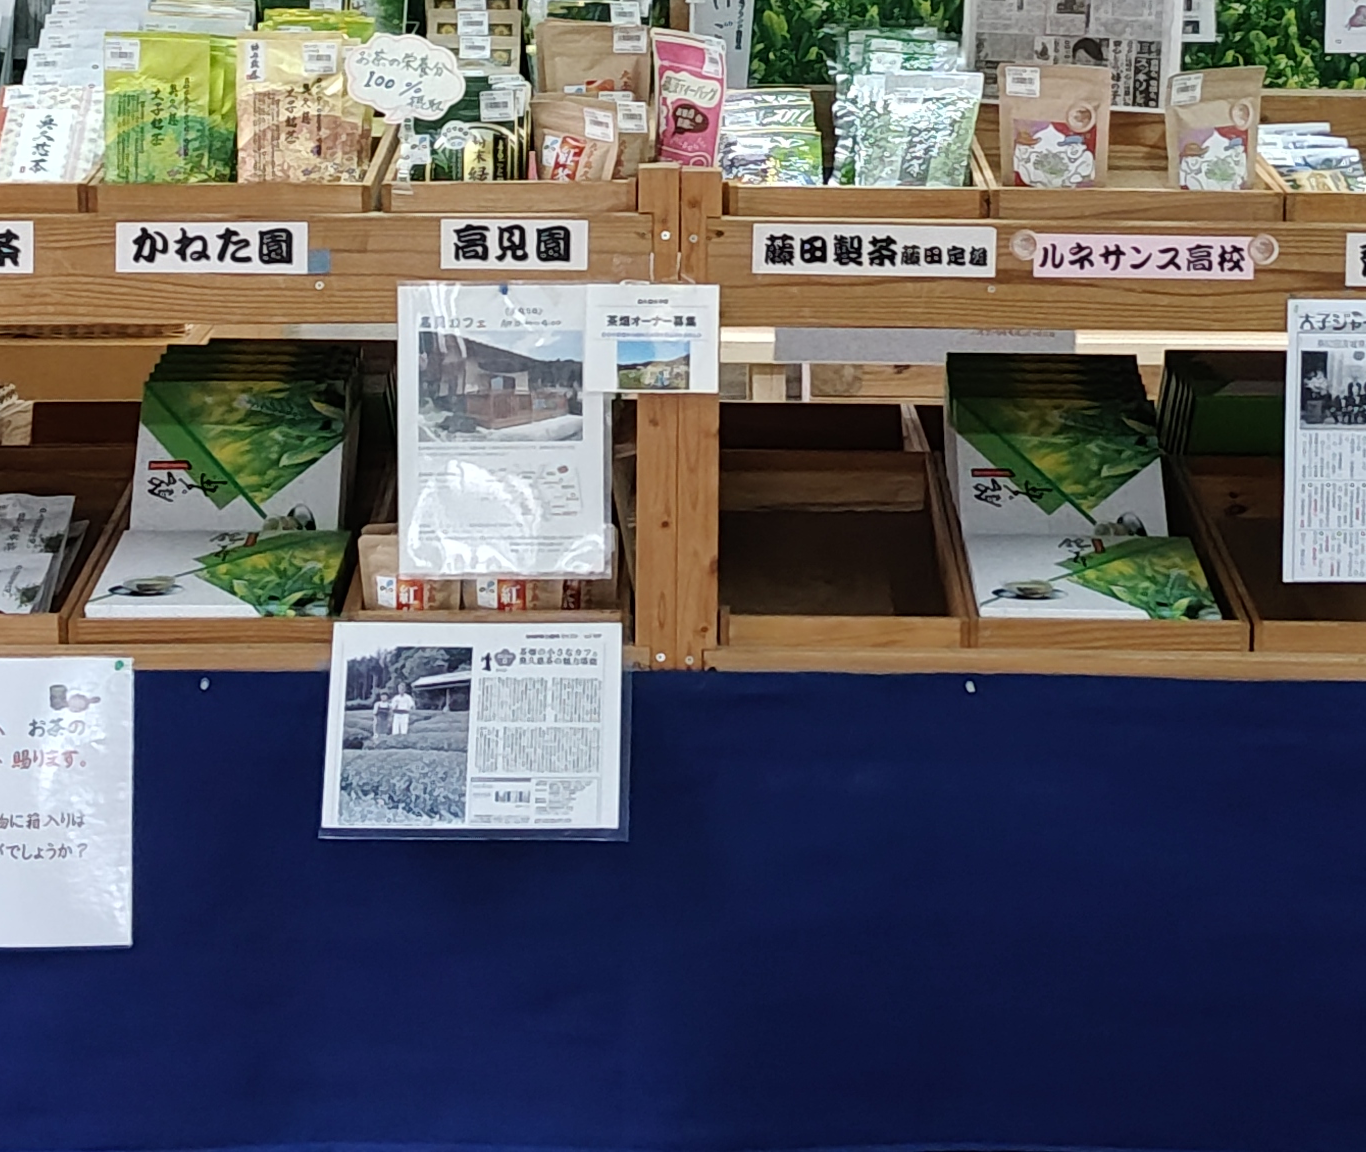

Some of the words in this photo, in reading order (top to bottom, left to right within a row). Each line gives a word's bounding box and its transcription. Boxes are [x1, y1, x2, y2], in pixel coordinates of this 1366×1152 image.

[363, 70, 395, 90] 100
[129, 225, 295, 266] かねた園
[450, 224, 572, 265] 高見園
[763, 233, 898, 269] 藤田製茶
[1035, 241, 1247, 278] ルネサンス高校
[28, 718, 87, 738] お茶の
